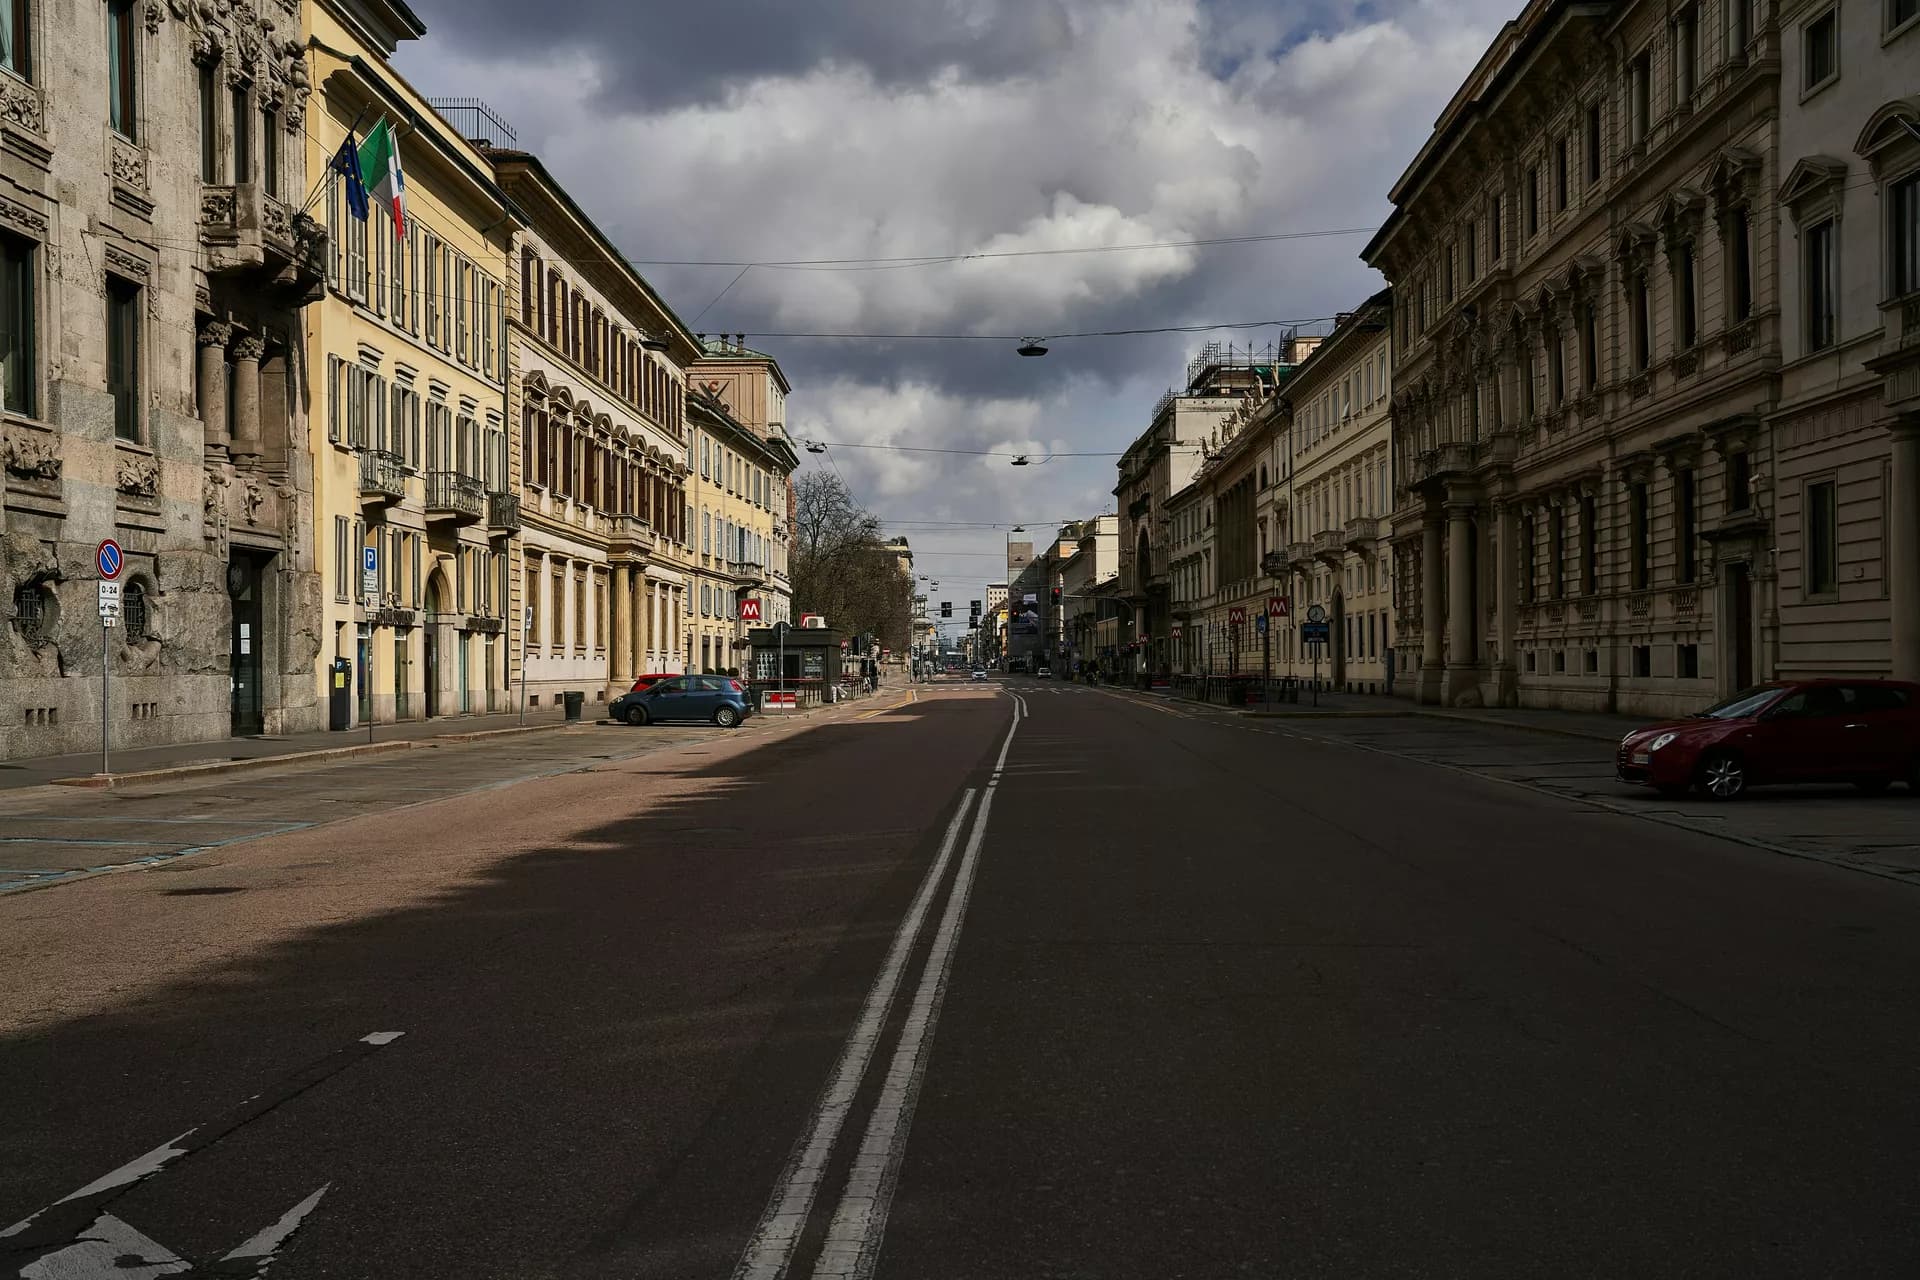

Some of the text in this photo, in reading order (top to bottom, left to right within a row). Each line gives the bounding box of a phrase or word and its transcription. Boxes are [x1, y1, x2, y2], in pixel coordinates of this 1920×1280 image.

[367, 551, 374, 567] P
[743, 603, 759, 615] M
[1271, 601, 1286, 613] M
[1230, 611, 1243, 621] M
[336, 661, 342, 669] P
